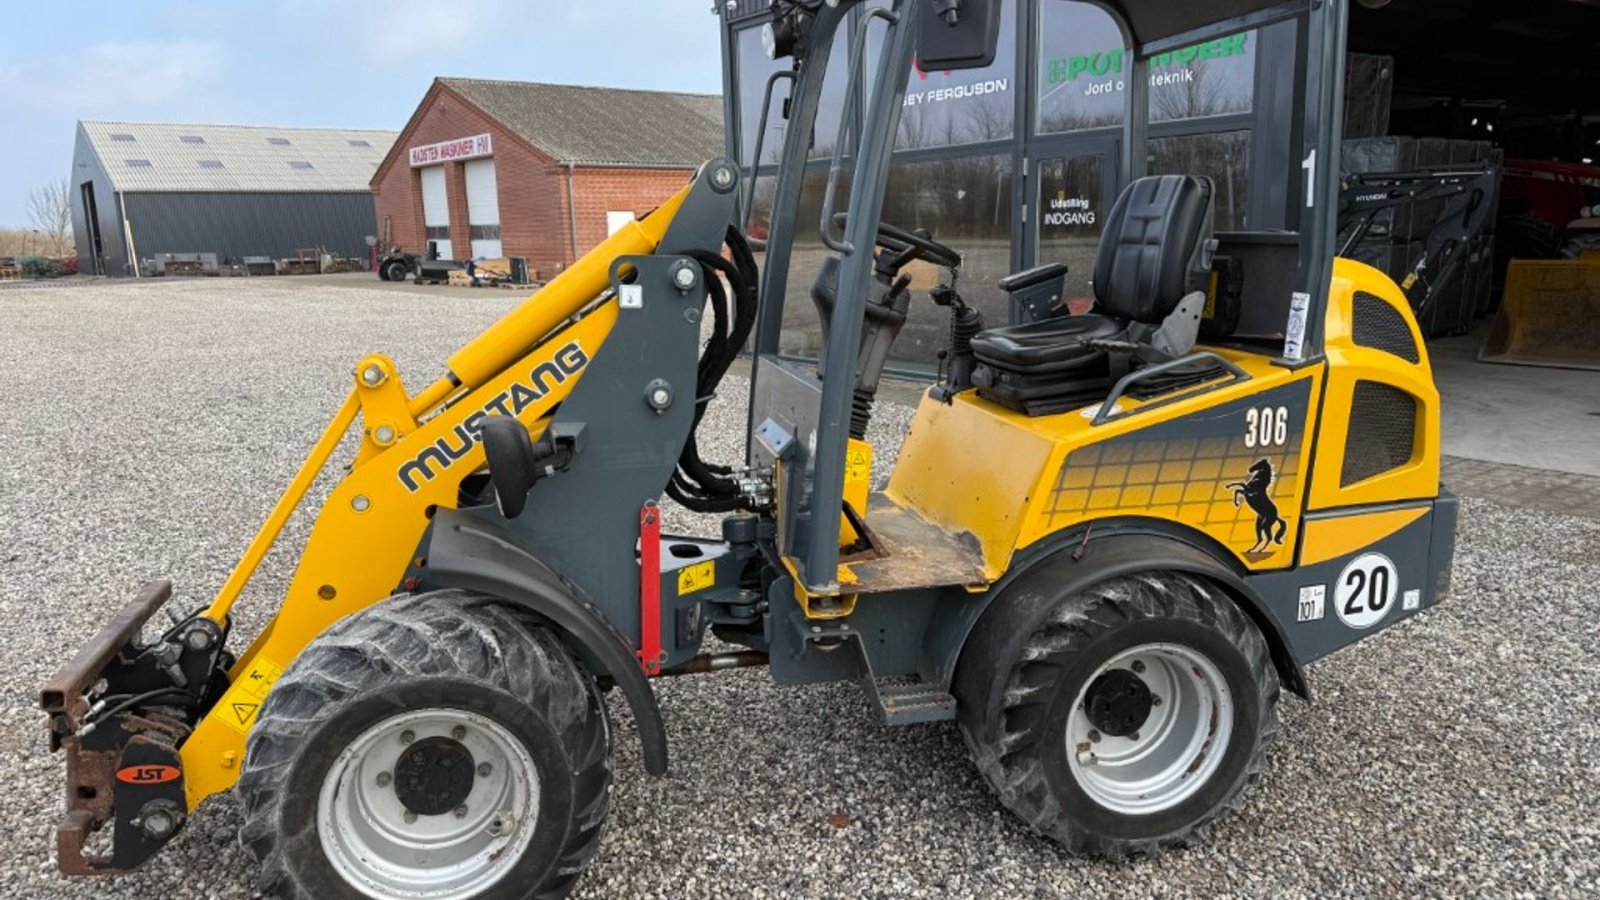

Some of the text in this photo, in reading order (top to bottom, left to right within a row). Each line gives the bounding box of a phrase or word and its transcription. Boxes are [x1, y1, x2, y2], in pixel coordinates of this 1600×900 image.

[927, 78, 1008, 103] FERGUSON
[1084, 79, 1113, 96] Jord
[440, 139, 474, 159] MASKINER
[1301, 149, 1316, 207] 1
[1044, 211, 1095, 225] INDGANG
[399, 341, 589, 492] MUSTANG
[1245, 406, 1288, 448] 306
[1343, 565, 1389, 616] 20
[1299, 600, 1315, 620] 101
[132, 768, 166, 781] JST
